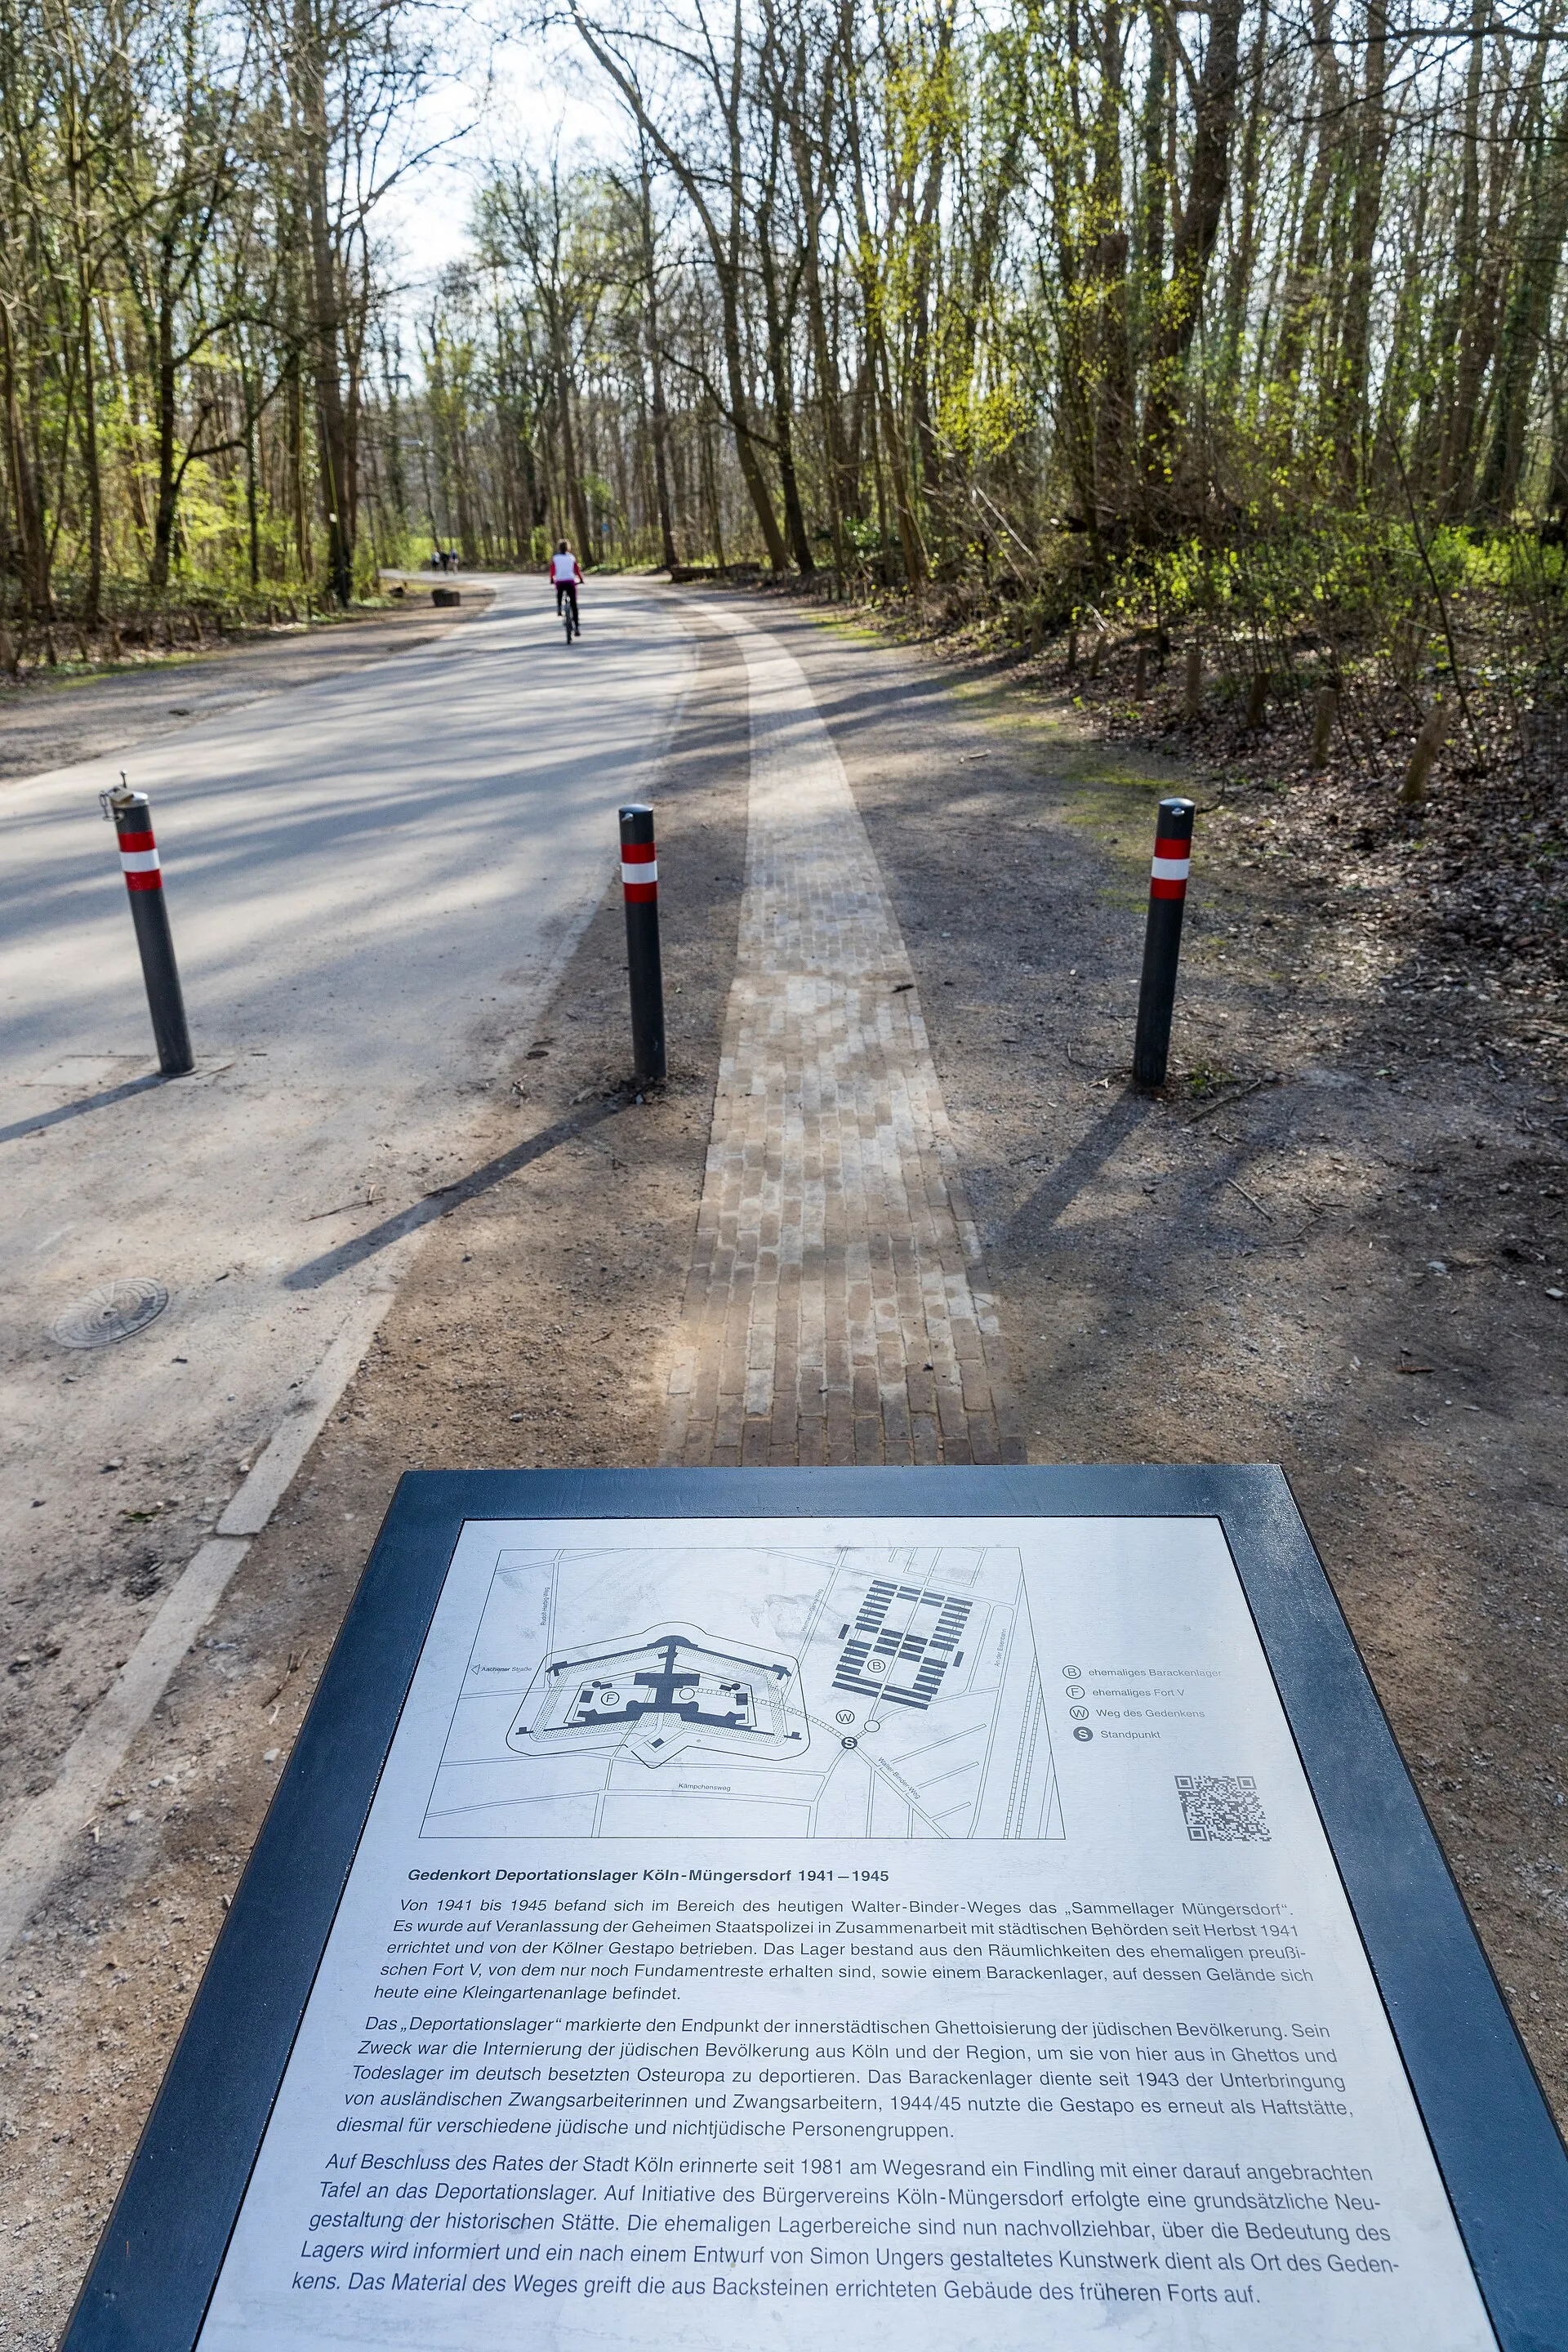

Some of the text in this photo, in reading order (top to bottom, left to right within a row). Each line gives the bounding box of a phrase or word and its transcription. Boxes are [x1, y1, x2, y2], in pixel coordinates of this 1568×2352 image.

[1089, 1668, 1146, 1677] ehemaliges
[1149, 1668, 1223, 1678] Barackenlager
[1093, 1689, 1151, 1698] ehemaliges
[1154, 1689, 1175, 1697] Fort
[1096, 1708, 1120, 1719] Weg
[1123, 1708, 1143, 1717] des
[1145, 1708, 1205, 1717] Gedenkens
[1100, 1730, 1161, 1740] Standpunkt
[878, 1757, 921, 1800] Walter-Binder-Weg
[408, 1869, 491, 1881] Gedenkort
[495, 1869, 639, 1883] Deportationslager
[643, 1869, 791, 1884] Köln-Müngersdorf
[401, 1899, 428, 1911] Von
[438, 1900, 471, 1911] 1941
[480, 1899, 502, 1911] bis
[511, 1900, 547, 1911] 1945
[555, 1899, 607, 1911] befand
[613, 1900, 644, 1912] sich
[652, 1900, 669, 1911] im
[677, 1900, 734, 1912] Bereich
[742, 1900, 770, 1912] des
[778, 1900, 843, 1915] heutigen
[851, 1900, 1021, 1917] Walter-Binder-Weges
[1029, 1901, 1057, 1913] das
[387, 1941, 1306, 1962] errichtet und von der Kölner Gestapo betrieben. Das Lager bestand aus den Räumlichkeiten des ehemaligen preußi-
[365, 2016, 398, 2030] Das
[565, 2018, 641, 2032] markierte
[646, 2018, 676, 2032] den
[682, 2018, 760, 2036] Endpunkt
[764, 2019, 791, 2033] der
[795, 2019, 929, 2034] innerstädtischen
[935, 2020, 1057, 2038] Ghettoisierung
[1061, 2021, 1088, 2035] der
[1092, 2021, 1172, 2039] jüdischen
[1176, 2022, 1287, 2041] Bevölkerung.
[1291, 2024, 1330, 2038] Sein
[353, 2065, 1346, 2092] Todeslager im deutsch besetzten Osteuropa zu deportieren. Das Barackenlager diente seit 1943 der Unterbringung
[345, 2091, 1353, 2118] von ausländischen Zwangsarbeiterinnen und Zwangsarbeitern, 1944/45 nutzte die Gestapo es erneut als Haftstätte,
[336, 2117, 954, 2141] diesmal für verschiedene jüdische und nichtjüdische Personengruppen.
[320, 2181, 1381, 2212] Tafel an das Deportationslager. Auf Initiative des Bürgervereins Köln-Müngersdorf erfolgte eine grundsätzliche Neu-
[309, 2211, 1391, 2245] gestaltung der historischen Stätte. Die ehemaligen Lagerbereiche sind nun nachvollziehbar, über die Bedeutung des
[292, 2271, 1260, 2303] kens. Das Material des Weges greift die aus Backsteinen errichteten Gebäude des früheren Forts auf.
